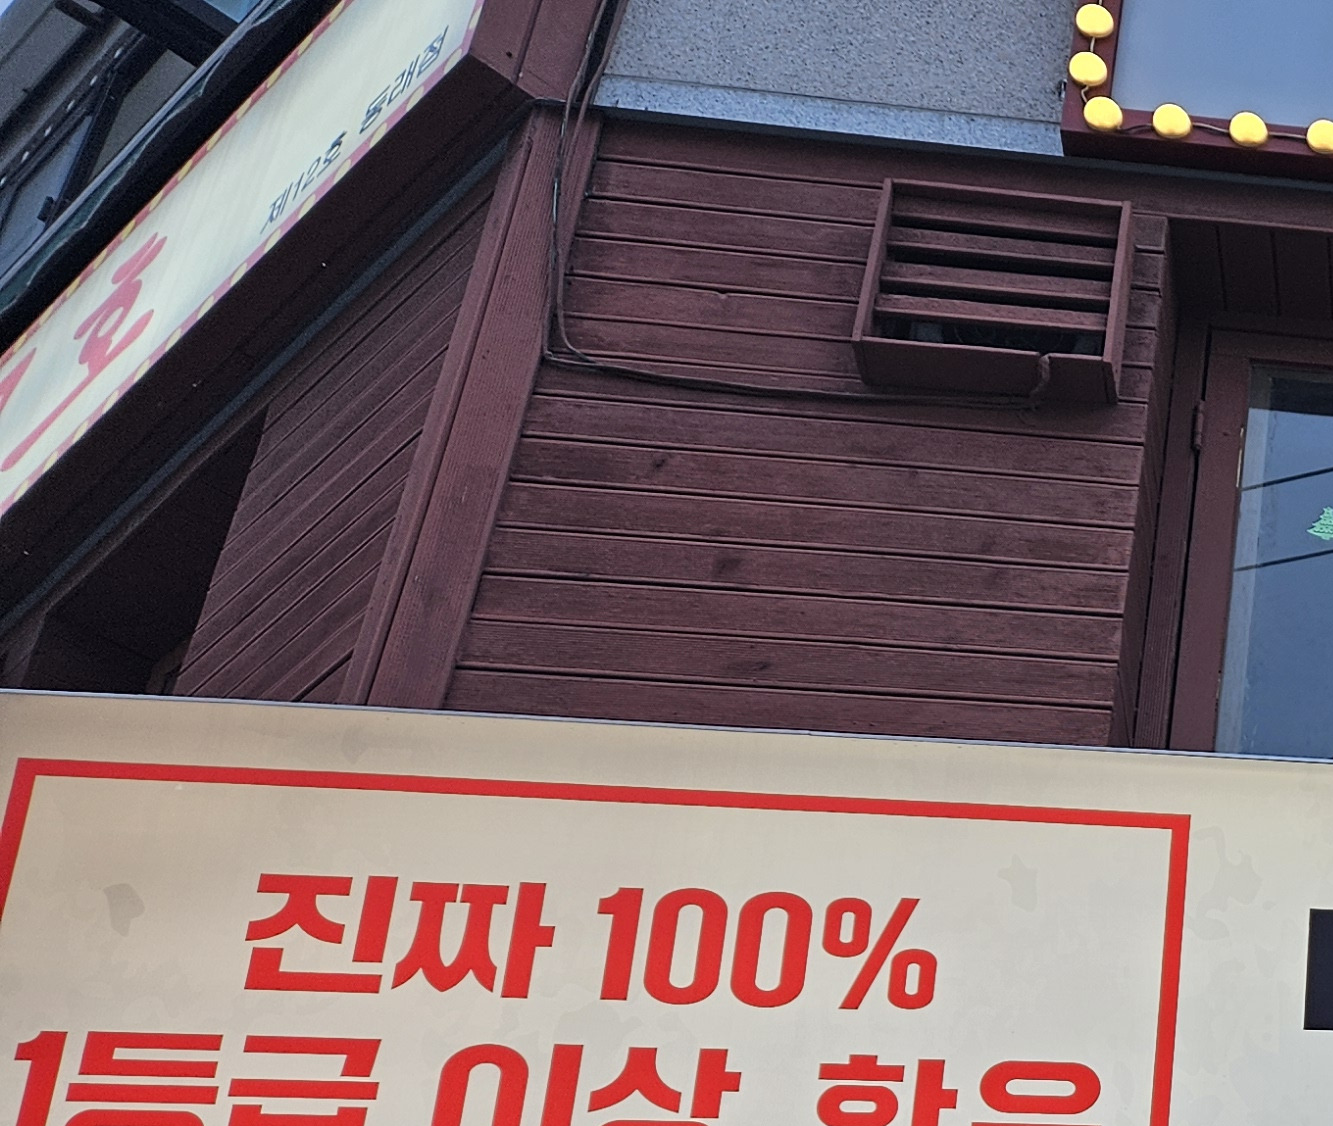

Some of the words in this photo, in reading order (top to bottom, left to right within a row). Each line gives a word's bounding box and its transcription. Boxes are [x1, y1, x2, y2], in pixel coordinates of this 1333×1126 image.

[358, 24, 449, 135] 동래점
[244, 873, 555, 999] 진짜
[598, 887, 938, 1010] 100%
